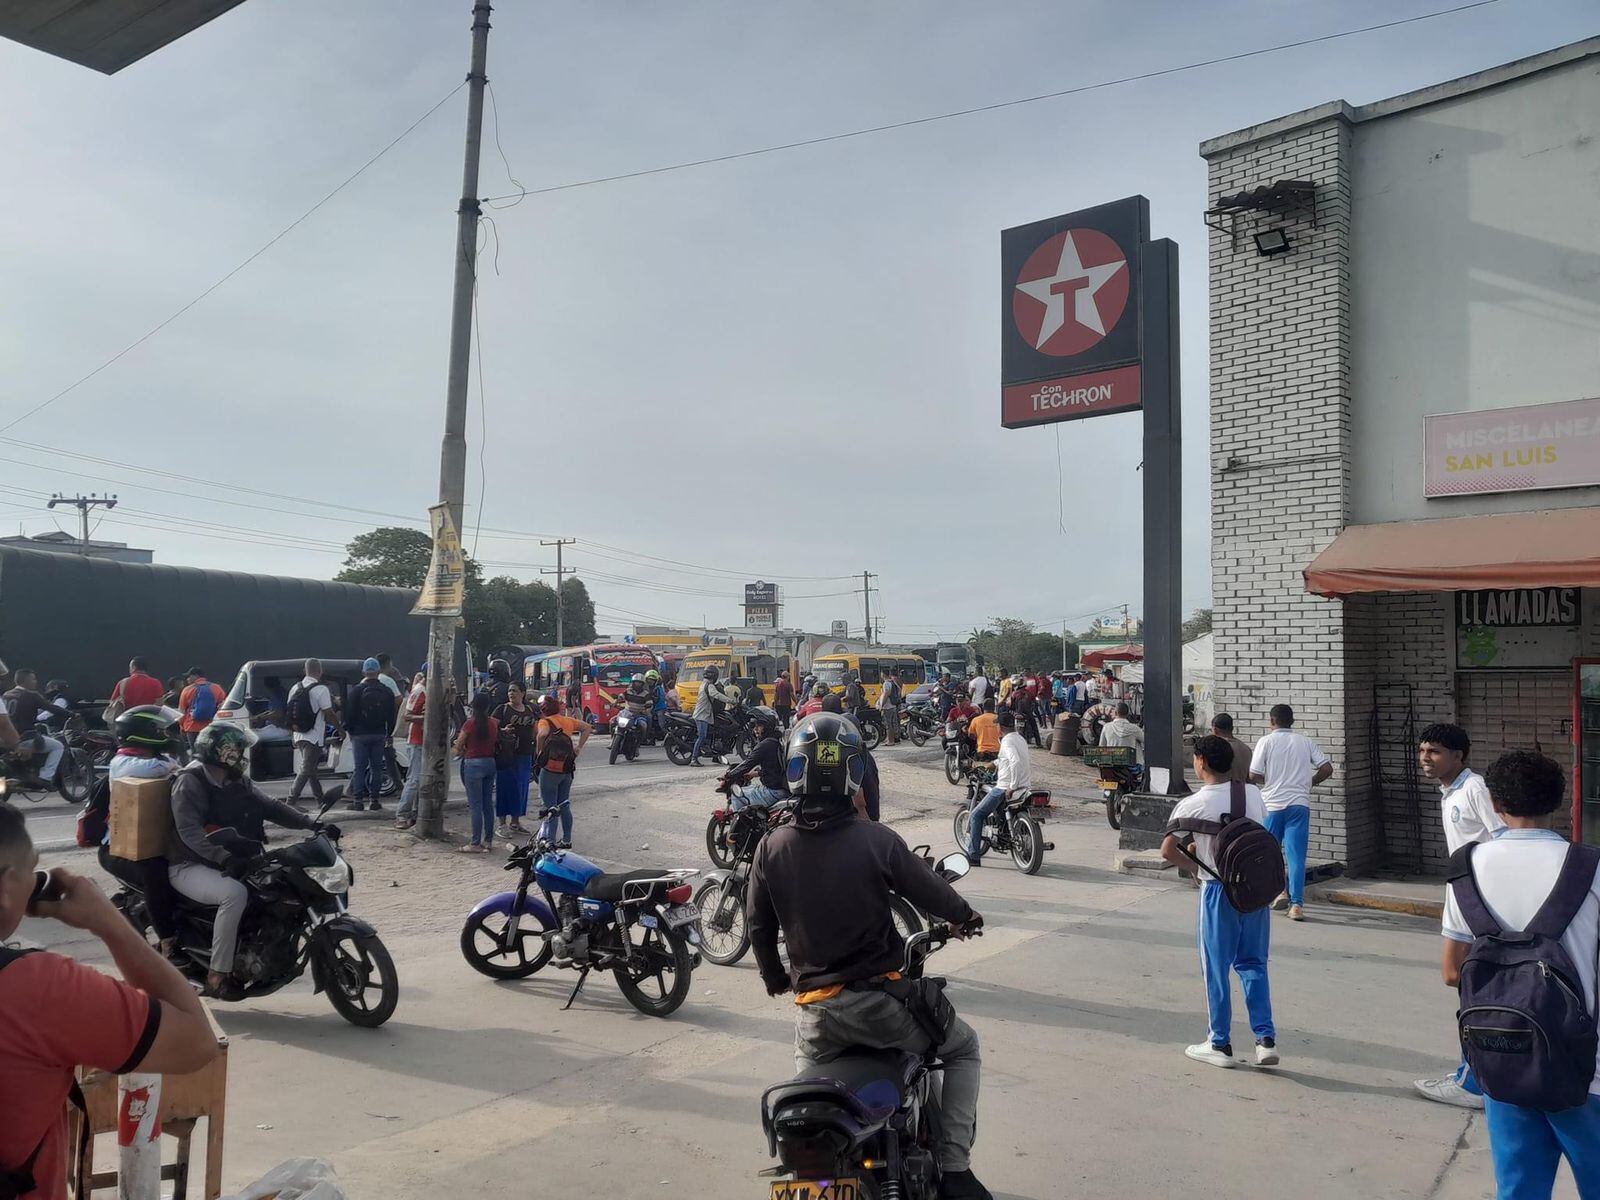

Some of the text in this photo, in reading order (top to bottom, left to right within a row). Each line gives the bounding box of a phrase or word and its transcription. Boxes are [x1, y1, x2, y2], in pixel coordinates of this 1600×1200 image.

[1031, 385, 1112, 412] TECHRON
[1040, 384, 1062, 395] Con
[1445, 446, 1558, 472] SAN LUIS
[1461, 588, 1576, 625] LLAMADAS
